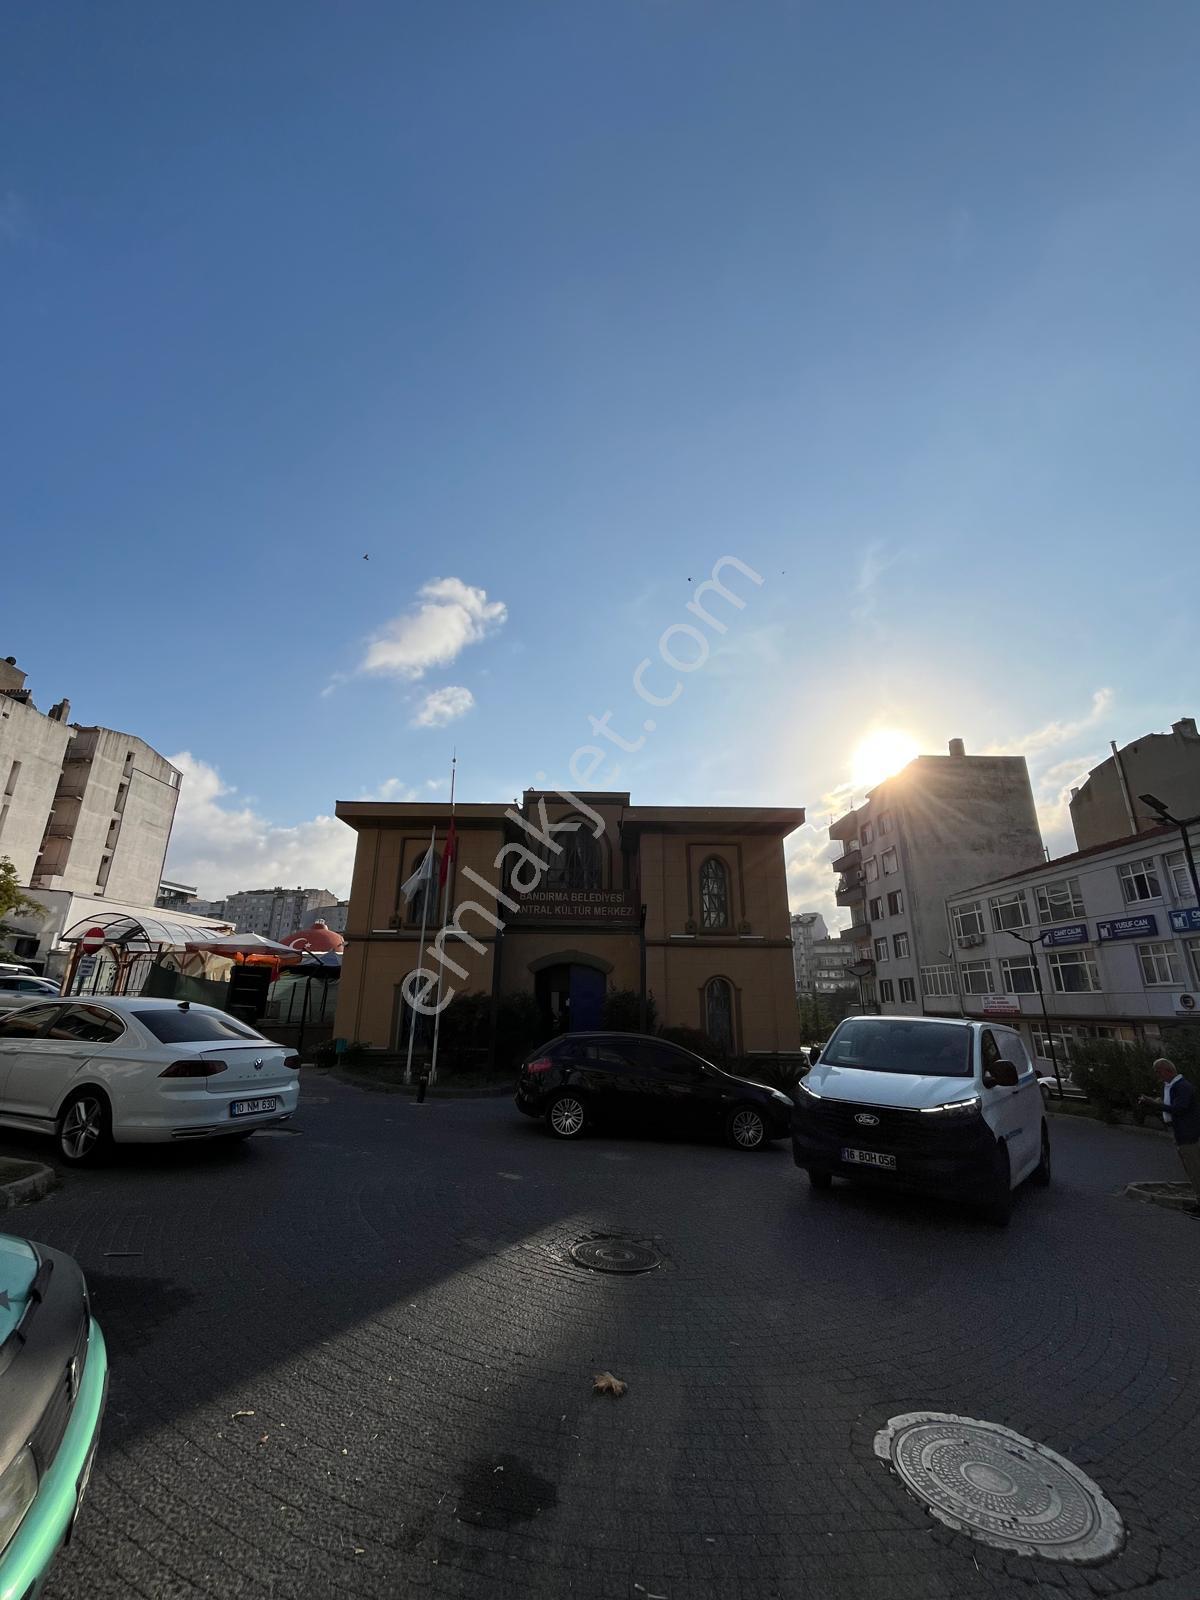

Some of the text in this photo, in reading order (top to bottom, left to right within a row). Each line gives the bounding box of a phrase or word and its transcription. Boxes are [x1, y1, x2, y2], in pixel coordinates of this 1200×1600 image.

[519, 891, 569, 901] BANDIRMA
[1133, 918, 1148, 927] CAN
[237, 1099, 275, 1113] 10 NM 630
[847, 1150, 855, 1160] 16
[878, 1155, 895, 1166] 058
